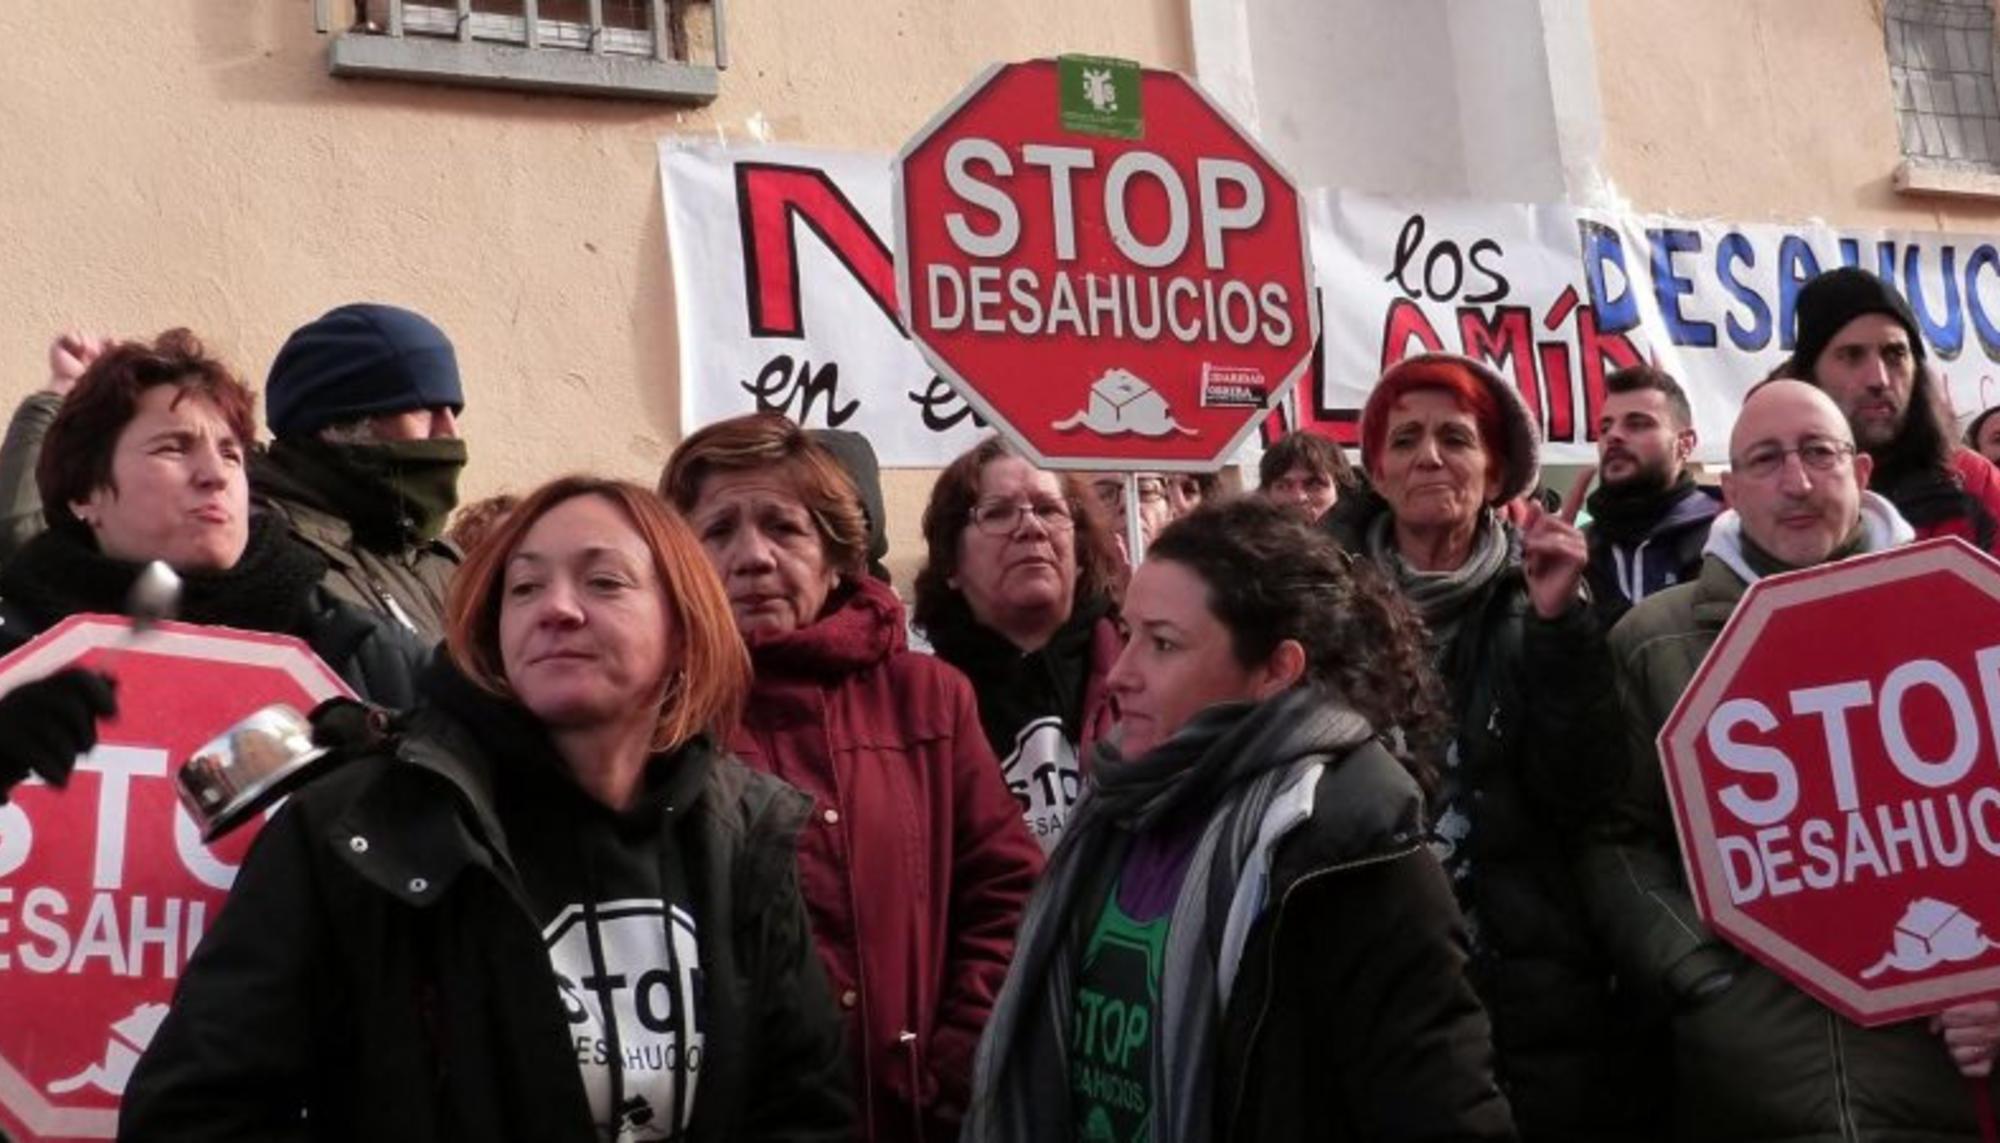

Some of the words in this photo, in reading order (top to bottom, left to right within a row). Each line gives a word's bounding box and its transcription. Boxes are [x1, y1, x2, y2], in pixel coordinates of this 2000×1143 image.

[944, 138, 1266, 269] STOP
[1385, 213, 1510, 302] los
[927, 264, 1293, 347] DESAHUCIOS
[741, 355, 861, 428] en
[908, 375, 988, 432] e
